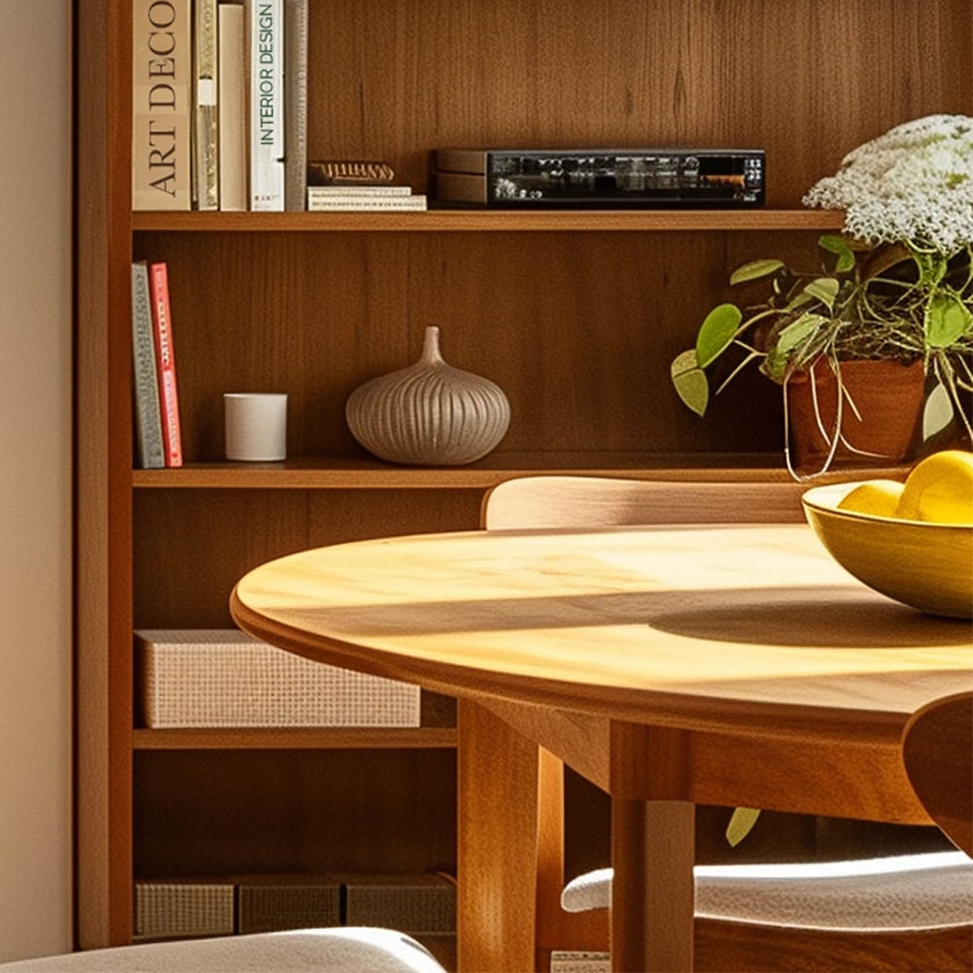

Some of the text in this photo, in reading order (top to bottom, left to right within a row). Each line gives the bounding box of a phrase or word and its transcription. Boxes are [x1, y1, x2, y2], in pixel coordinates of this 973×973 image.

[147, 0, 176, 197] ART DECO
[259, 4, 274, 145] INTERIOR DESIGN
